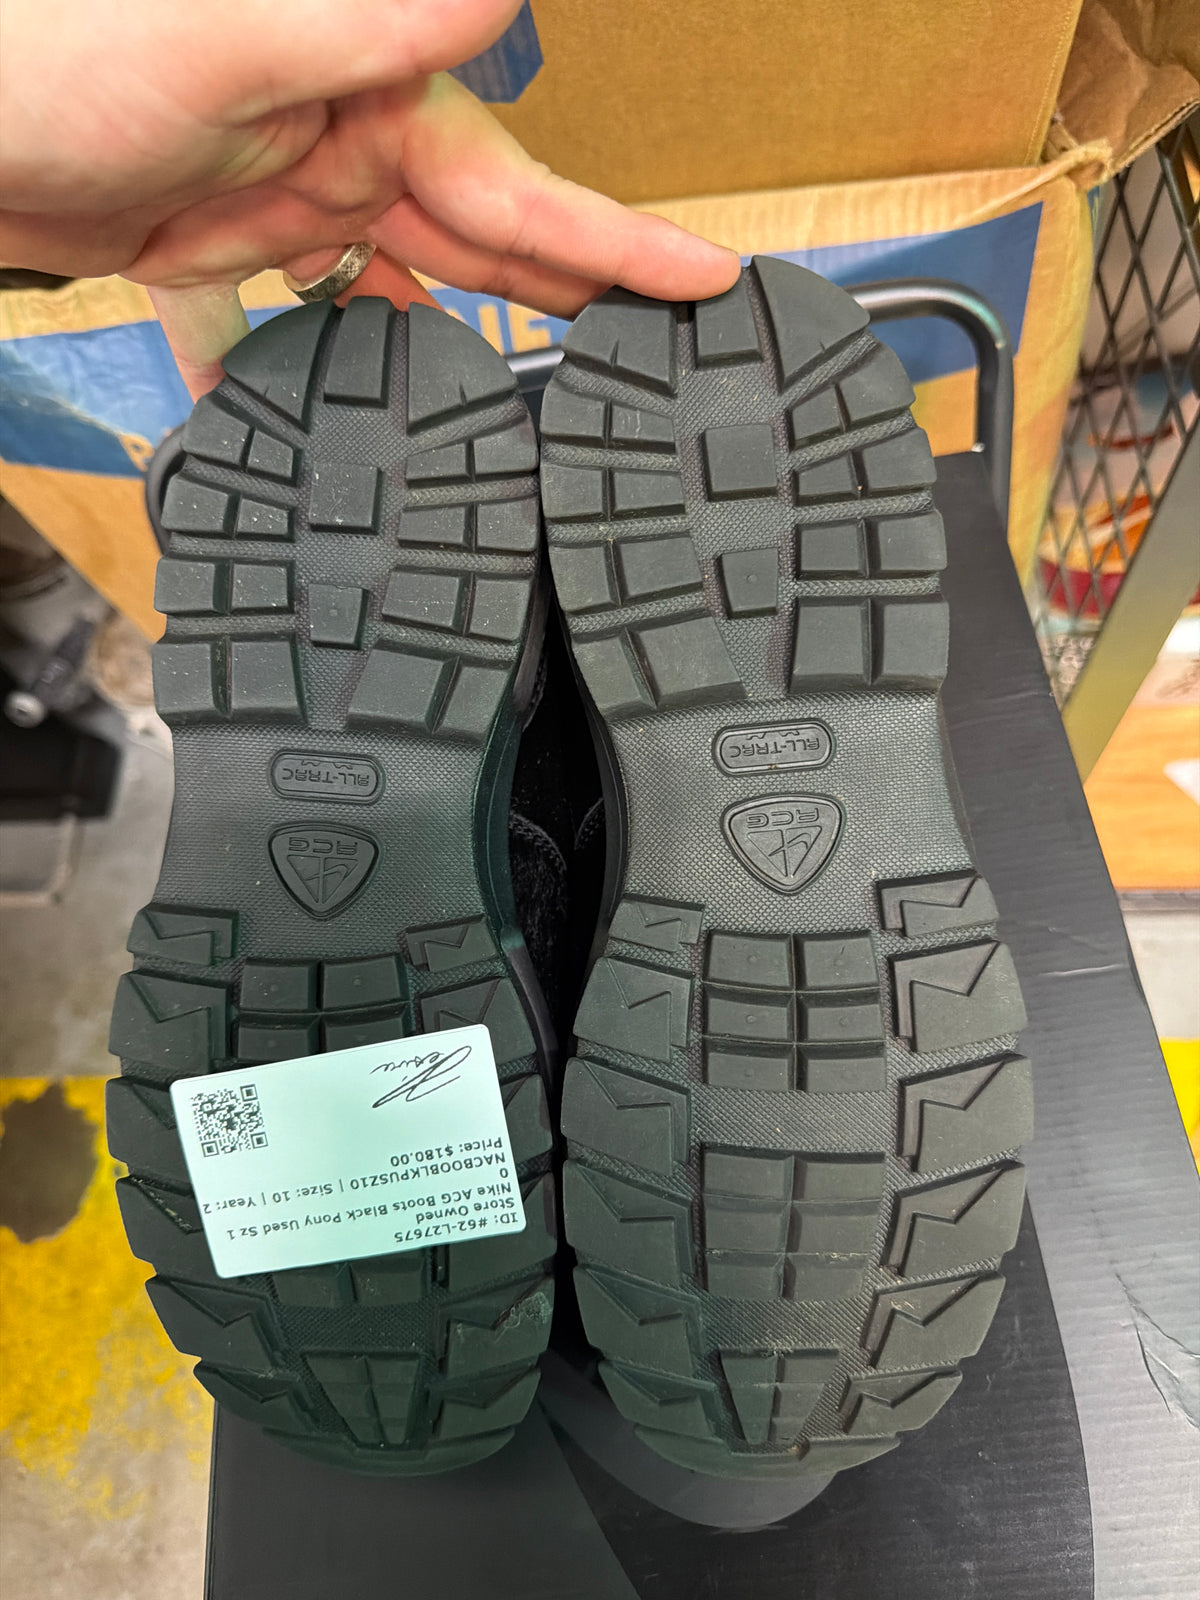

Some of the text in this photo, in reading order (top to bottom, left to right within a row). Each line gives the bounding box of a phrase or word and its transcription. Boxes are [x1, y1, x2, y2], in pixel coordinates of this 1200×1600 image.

[728, 738, 820, 758] ALL-TRAC
[282, 767, 369, 787] ALL-TRAC
[746, 808, 820, 828] ACG
[288, 837, 358, 856] ACG
[390, 1137, 503, 1167] Price: $180.00
[499, 1167, 509, 1179] 0
[272, 1191, 290, 1203] 10
[296, 1183, 333, 1198] Size:
[203, 1204, 211, 1214] 2
[216, 1195, 256, 1211] Year:
[227, 1182, 511, 1240] Nike ACG Boots Black Pony Used Sz 1
[415, 1197, 515, 1225] Store Owned
[394, 1212, 518, 1243] ID: #62-L27675
